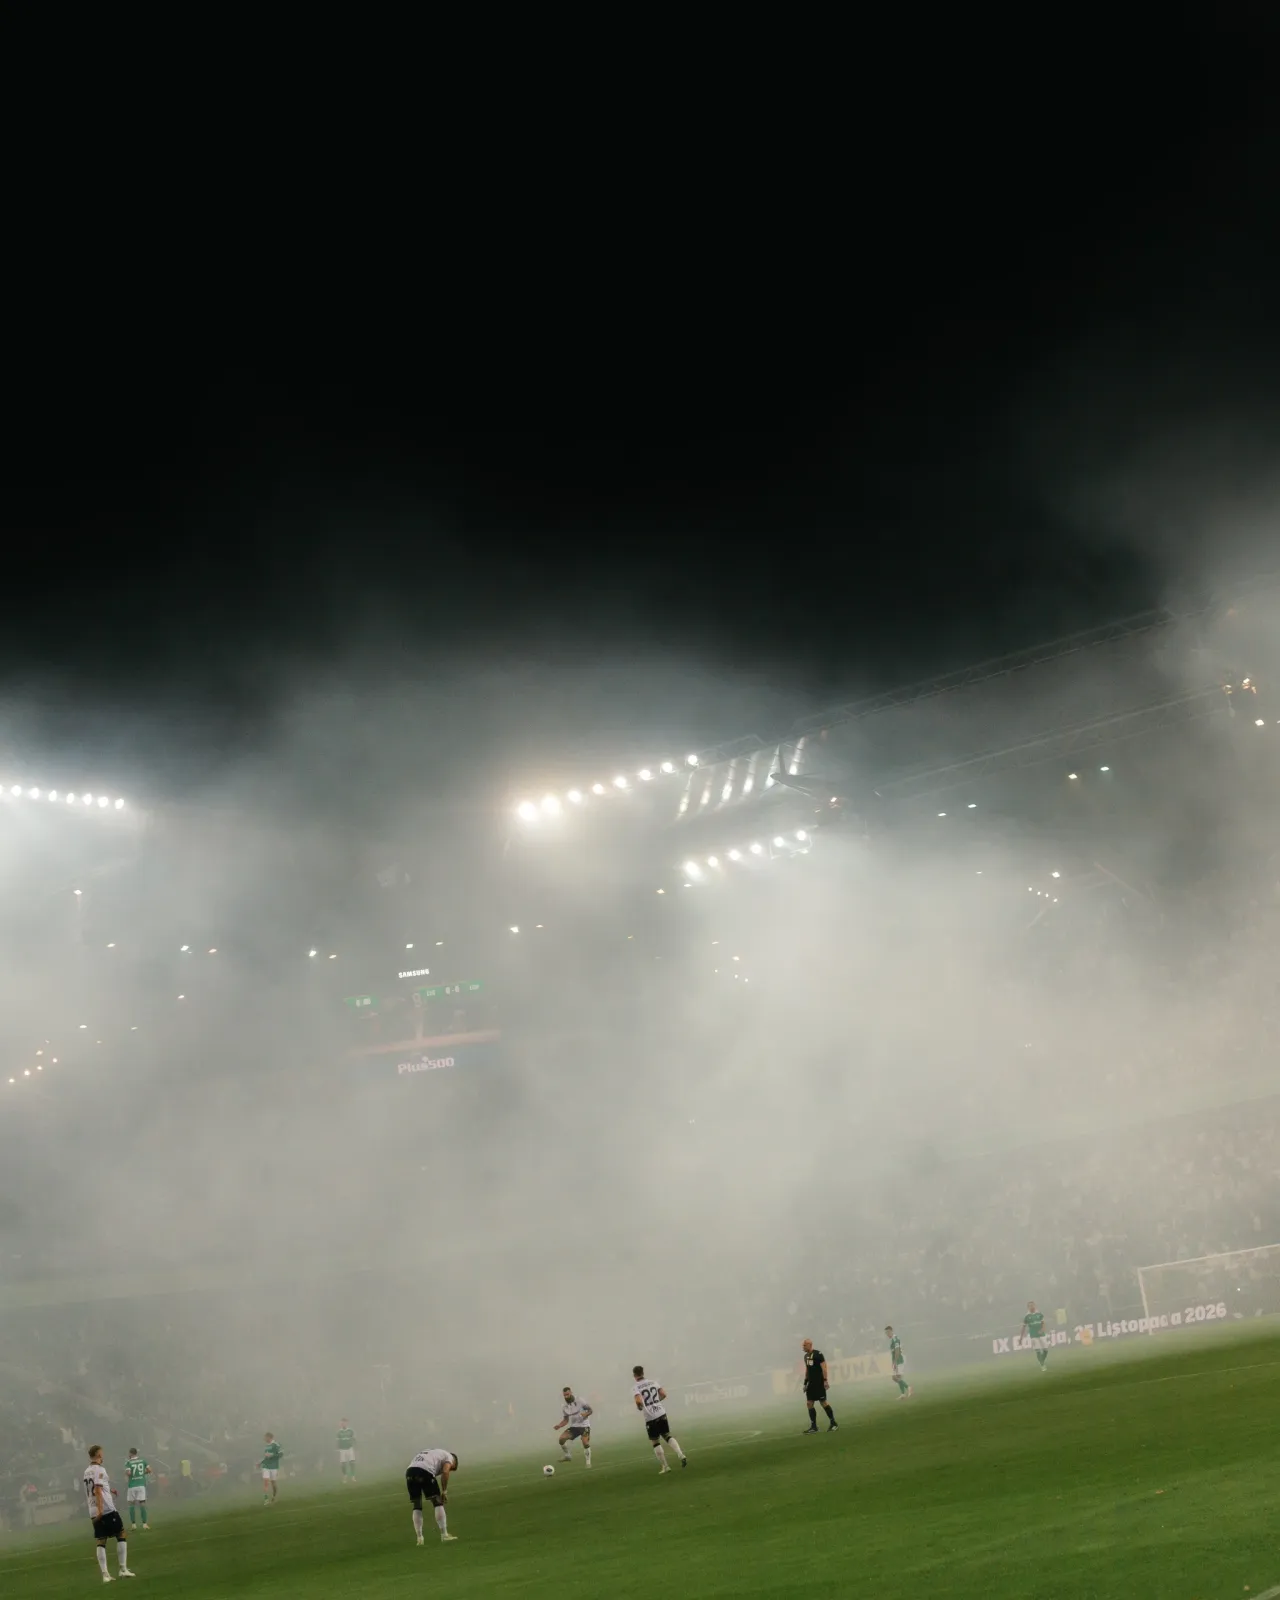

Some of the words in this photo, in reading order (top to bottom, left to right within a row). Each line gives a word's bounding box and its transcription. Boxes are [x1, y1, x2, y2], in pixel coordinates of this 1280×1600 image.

[398, 967, 430, 979] SAMSUNG
[397, 1056, 455, 1074] Plus500
[992, 1337, 1010, 1354] IX
[1184, 1302, 1227, 1323] 2026
[641, 1386, 659, 1407] 22
[131, 1463, 144, 1477] 79
